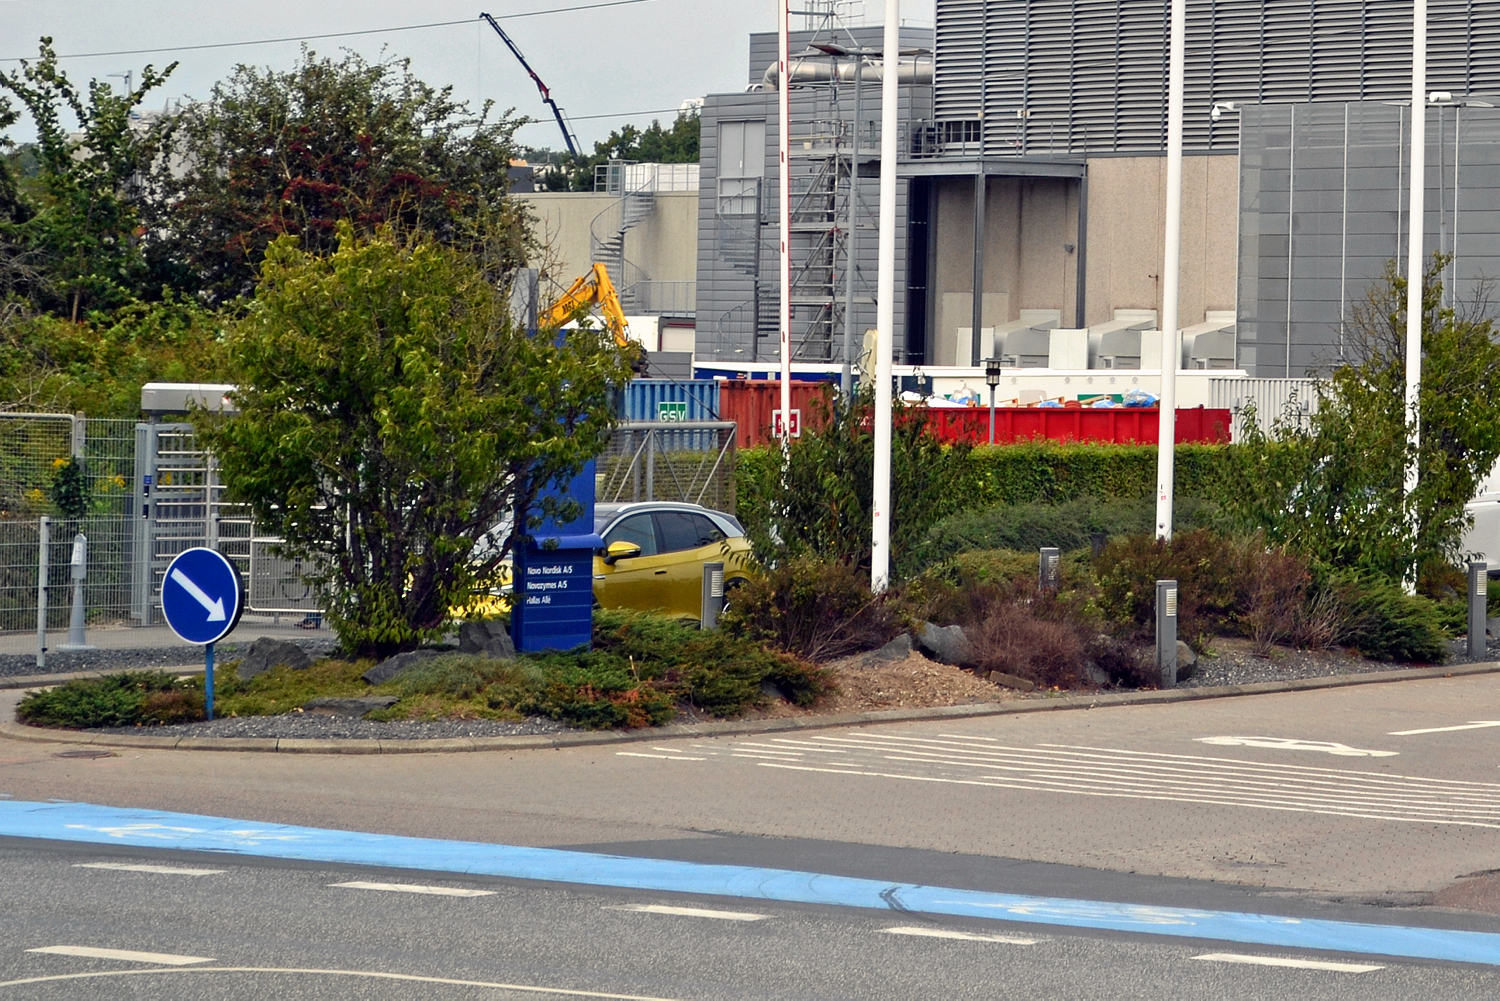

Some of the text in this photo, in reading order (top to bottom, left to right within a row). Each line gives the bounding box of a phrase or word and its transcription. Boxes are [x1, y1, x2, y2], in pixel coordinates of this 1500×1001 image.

[660, 410, 686, 422] GSV
[527, 565, 573, 575] Novo Nordisk A/S
[557, 580, 568, 588] A/S
